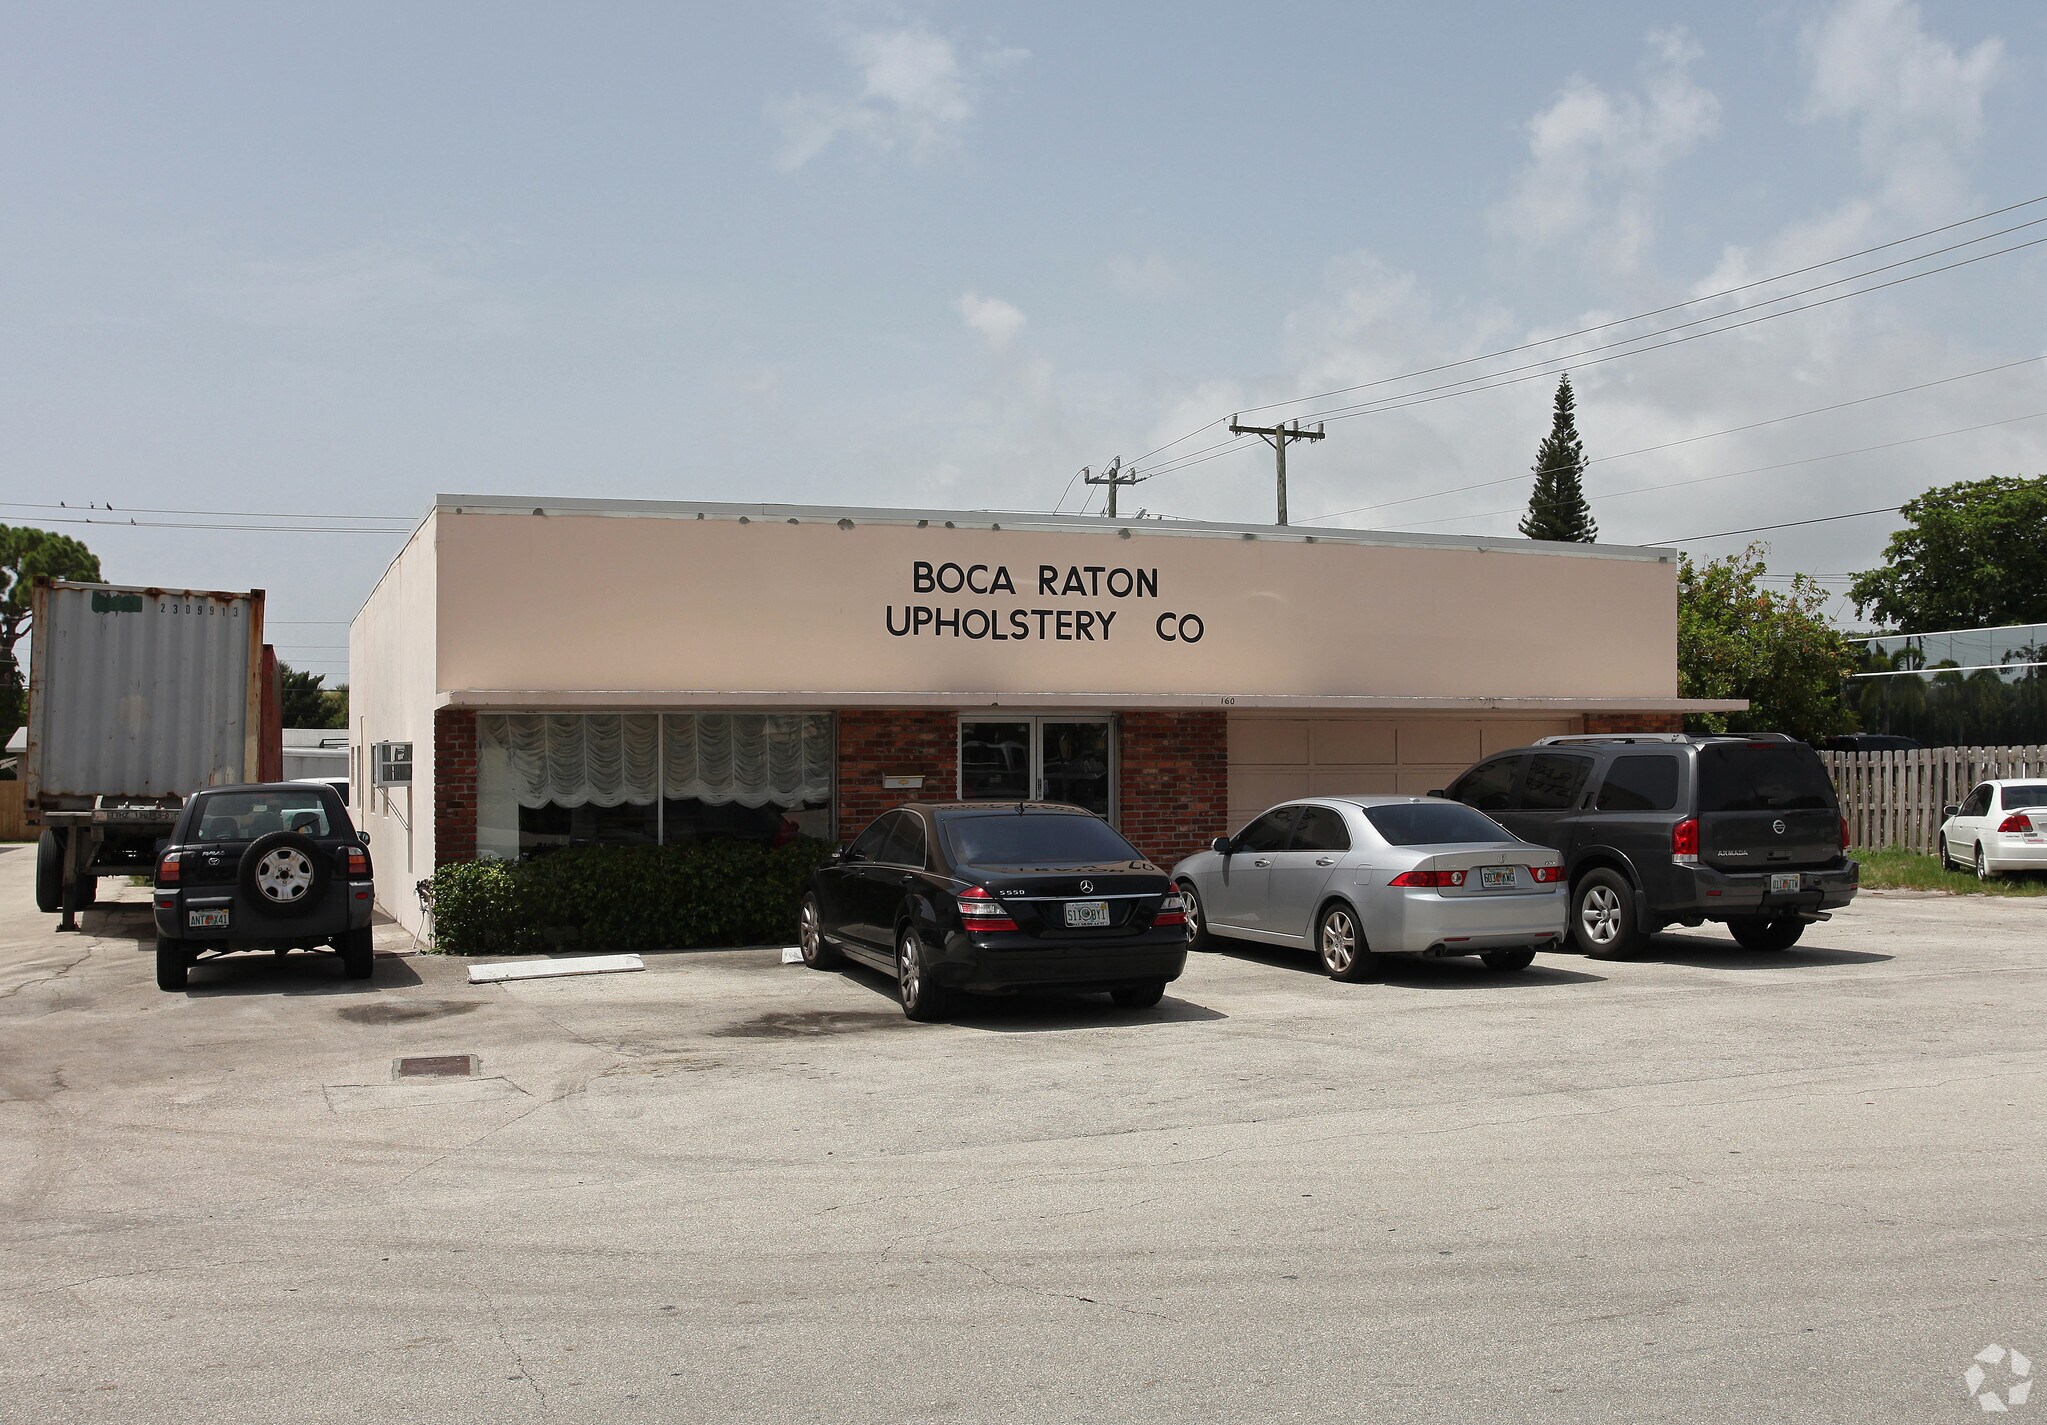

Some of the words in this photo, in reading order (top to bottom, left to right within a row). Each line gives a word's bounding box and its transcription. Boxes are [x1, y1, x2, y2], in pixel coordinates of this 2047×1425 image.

[914, 562, 1016, 594] BOCA
[1039, 565, 1157, 597] RATON
[887, 606, 1116, 640] UPHOLSTERY
[1156, 612, 1204, 643] CO
[1221, 697, 1235, 705] 160
